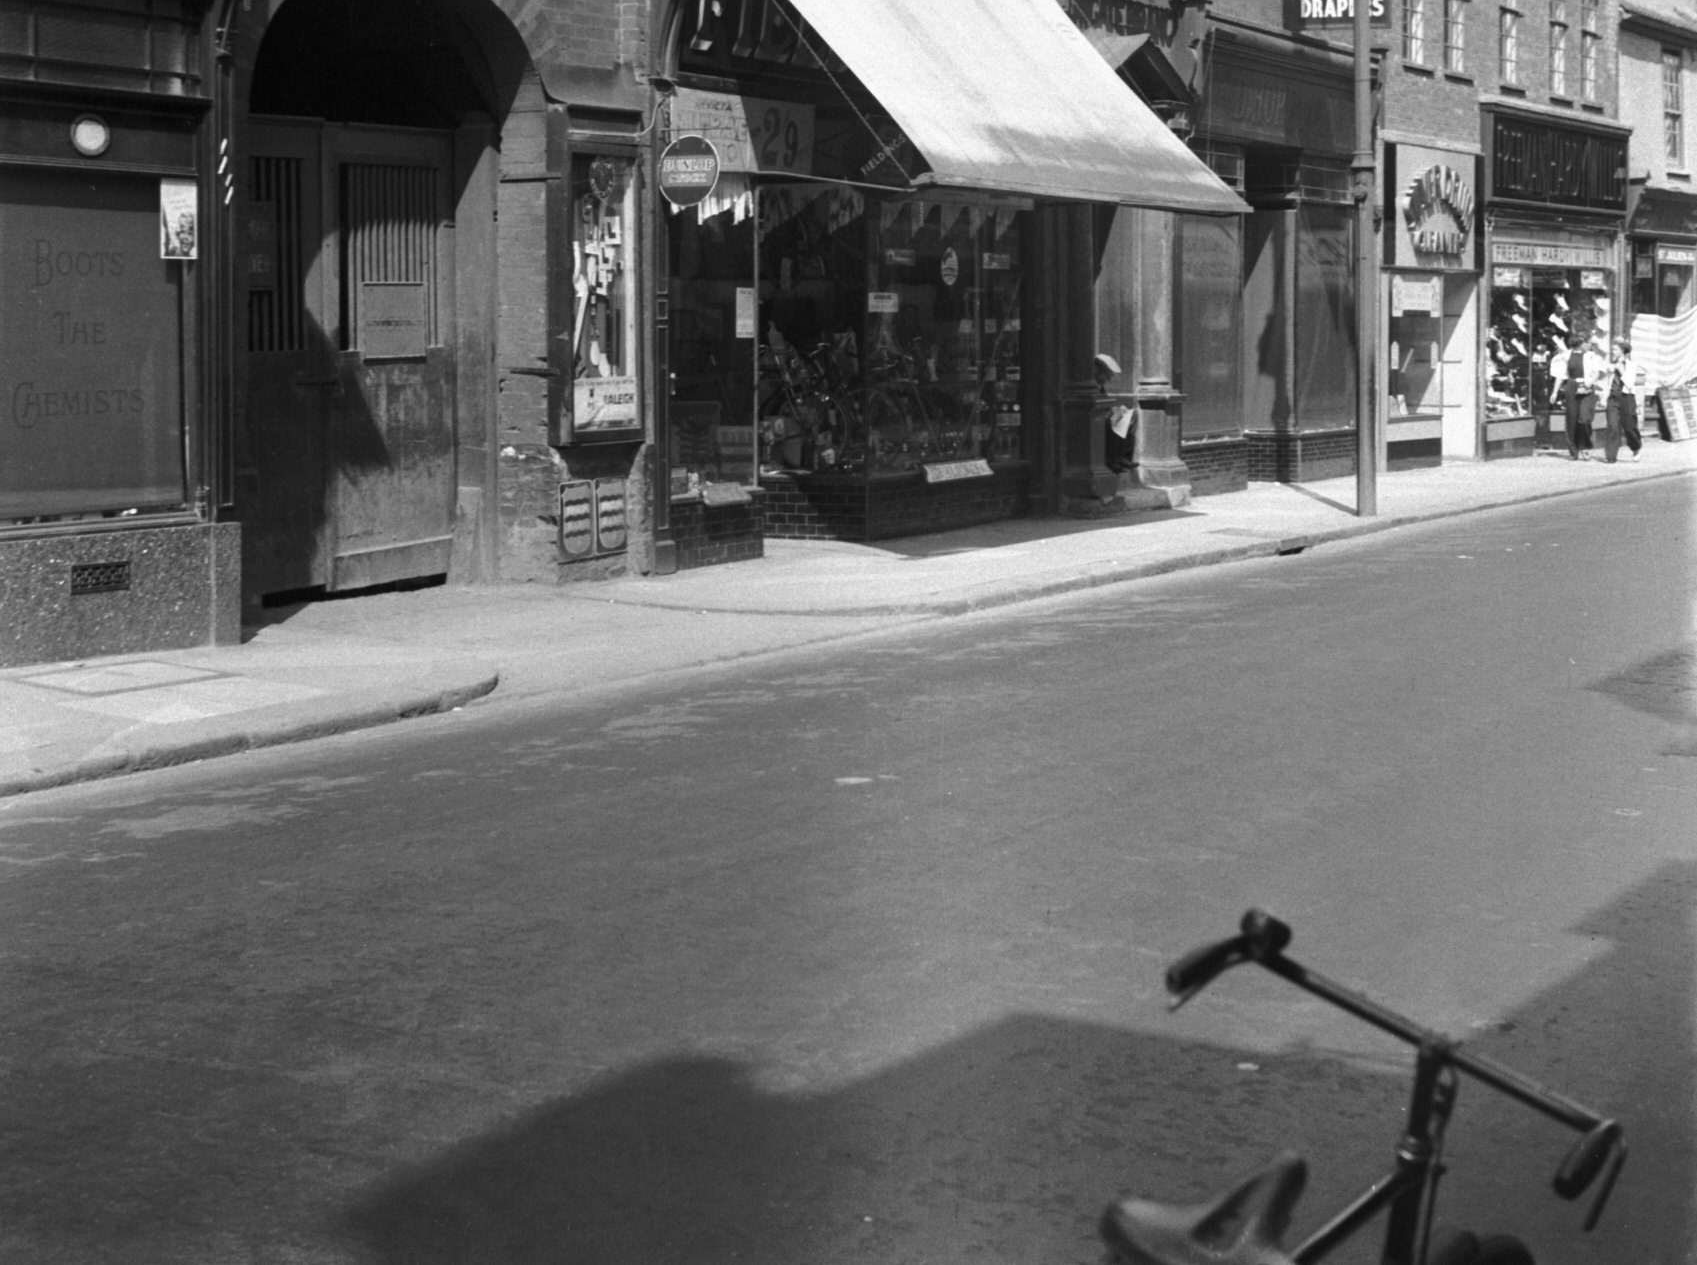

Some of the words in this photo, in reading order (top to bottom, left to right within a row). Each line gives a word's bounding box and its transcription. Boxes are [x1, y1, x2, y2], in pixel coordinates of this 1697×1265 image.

[663, 158, 715, 172] DUNLOP
[52, 311, 107, 345] THE
[12, 381, 145, 429] CHEMISTS
